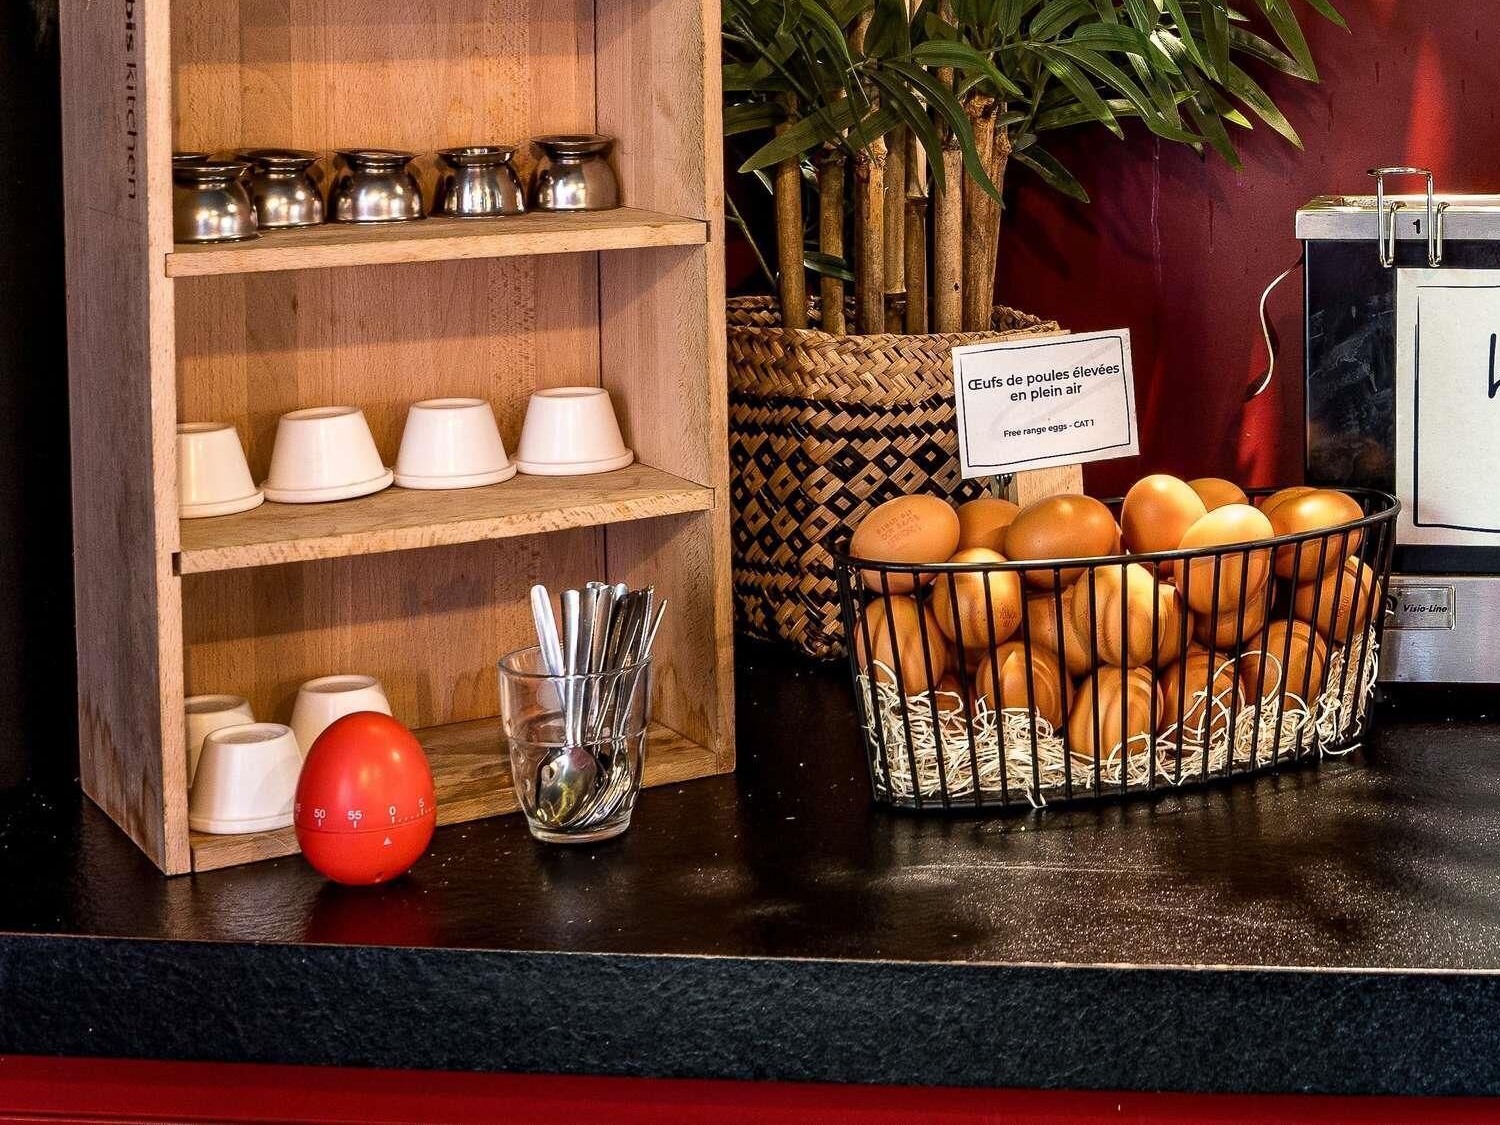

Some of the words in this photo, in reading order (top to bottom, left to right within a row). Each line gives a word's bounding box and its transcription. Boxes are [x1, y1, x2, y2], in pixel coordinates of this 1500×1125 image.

[126, 62, 138, 200] kitchen
[1412, 218, 1421, 234] 1
[967, 376, 1004, 391] Œufs
[1006, 374, 1023, 386] de
[1026, 369, 1070, 387] poules
[1072, 364, 1120, 379] élevées
[1010, 390, 1027, 402] en
[1030, 385, 1063, 402] plein
[1066, 382, 1083, 395] air
[1003, 429, 1022, 438] Free
[1023, 426, 1047, 436] range
[1048, 423, 1068, 433] eggs
[1073, 420, 1090, 429] CAT
[1403, 604, 1448, 614] Visio-Line
[313, 808, 326, 819] 50
[347, 810, 363, 820] 55
[388, 805, 397, 815] 0
[418, 797, 425, 808] 5
